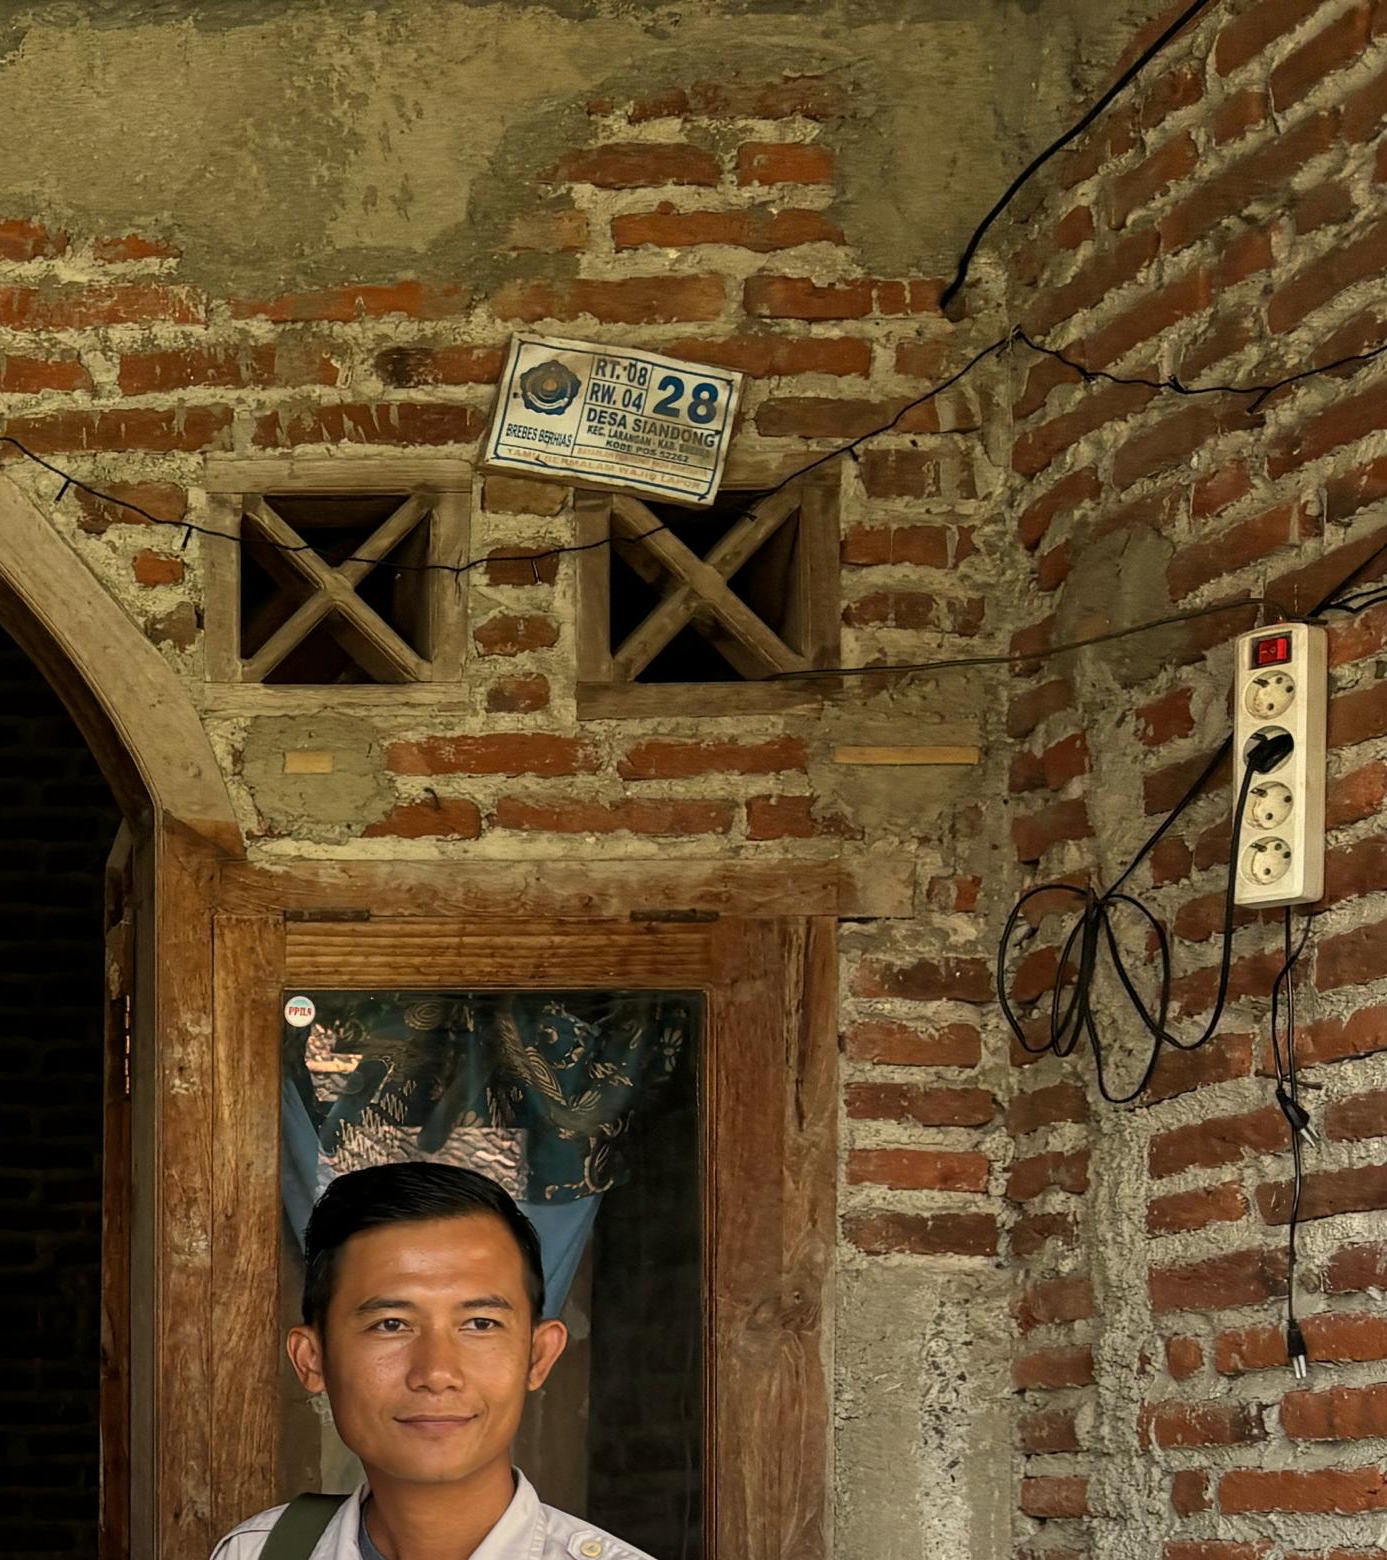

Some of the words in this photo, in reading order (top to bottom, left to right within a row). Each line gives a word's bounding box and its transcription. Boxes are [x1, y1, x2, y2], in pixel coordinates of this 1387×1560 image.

[595, 359, 620, 380] RT.
[626, 363, 648, 387] 08
[589, 383, 616, 405] RW.
[621, 391, 644, 413] 04
[653, 375, 719, 424] 28
[506, 423, 538, 442] BREBES
[586, 408, 627, 430] DESA
[631, 419, 715, 448] SIANDONG
